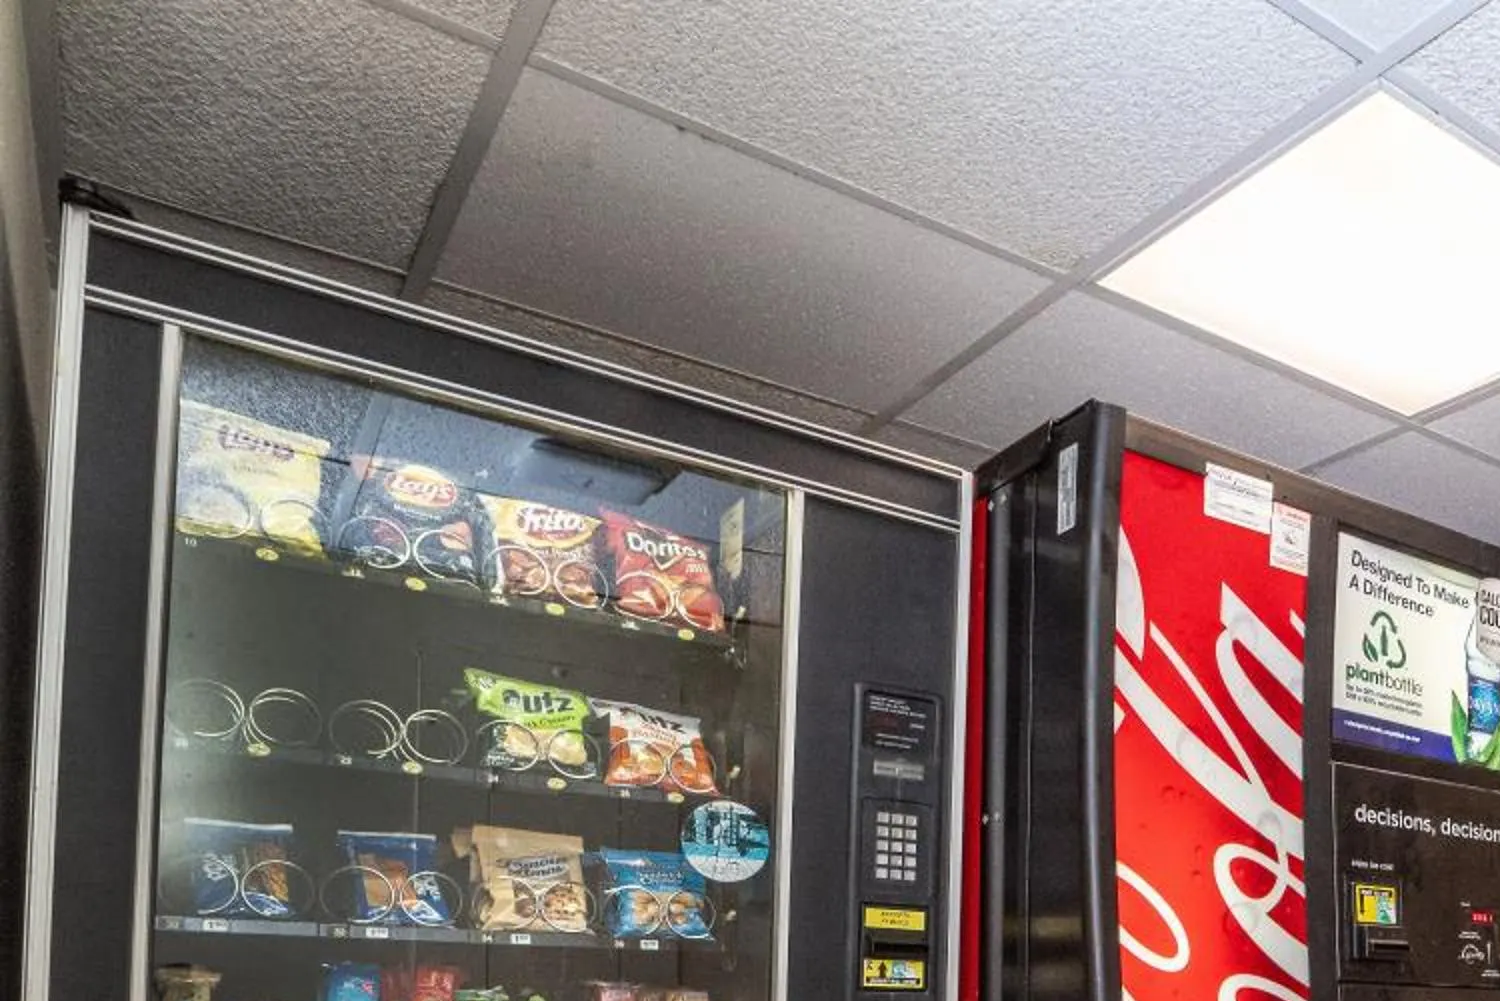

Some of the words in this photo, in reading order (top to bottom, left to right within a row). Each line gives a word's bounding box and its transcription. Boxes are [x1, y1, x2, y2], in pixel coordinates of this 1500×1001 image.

[625, 530, 708, 561] Doritos
[1348, 574, 1360, 592] A
[1363, 578, 1434, 617] Difference
[1351, 549, 1413, 588] Designed
[1416, 577, 1431, 595] To
[1433, 583, 1469, 609] Make
[1345, 662, 1423, 697] plantbottle
[1354, 803, 1437, 837] decisions,
